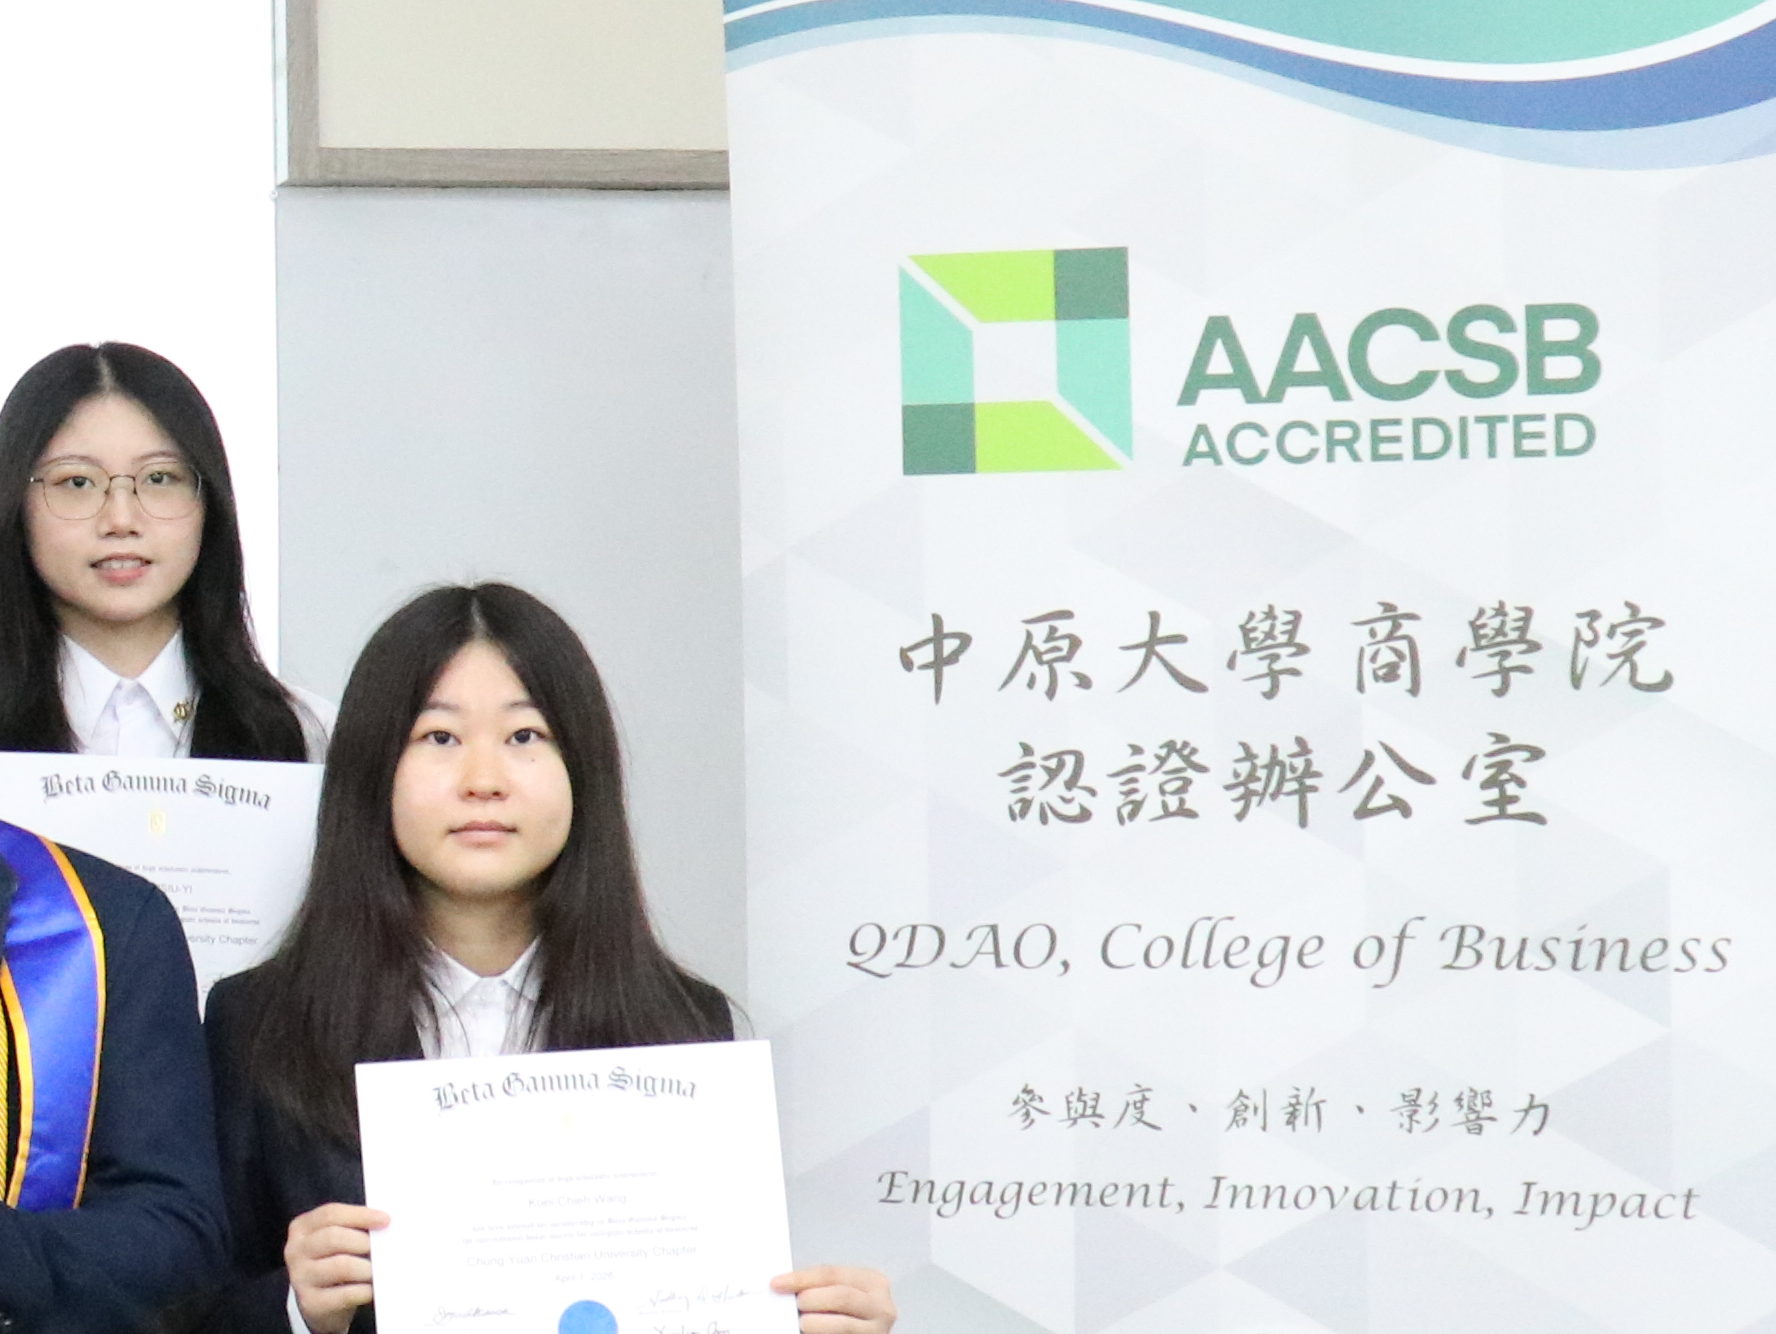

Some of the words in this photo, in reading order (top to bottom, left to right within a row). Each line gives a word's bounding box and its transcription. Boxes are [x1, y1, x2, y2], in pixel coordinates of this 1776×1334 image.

[1176, 302, 1602, 407] AACSB
[1182, 412, 1597, 467] ACCREDITED
[898, 601, 1677, 706] 中原大學商學院
[40, 772, 96, 799] Beta
[101, 769, 187, 794] Gamma
[192, 773, 271, 811] Sigma
[997, 732, 1550, 831] 認證辦公室
[845, 920, 1072, 980] QDAO,
[1099, 915, 1327, 990] College
[1351, 914, 1428, 990] of
[1438, 921, 1733, 975] Business
[432, 1080, 495, 1114] Beta
[501, 1071, 600, 1098] Gamma
[606, 1065, 698, 1101] Sigma
[875, 1169, 1187, 1220] Engagement,
[1202, 1175, 1496, 1221] Innovation,
[1512, 1178, 1702, 1232] Impact
